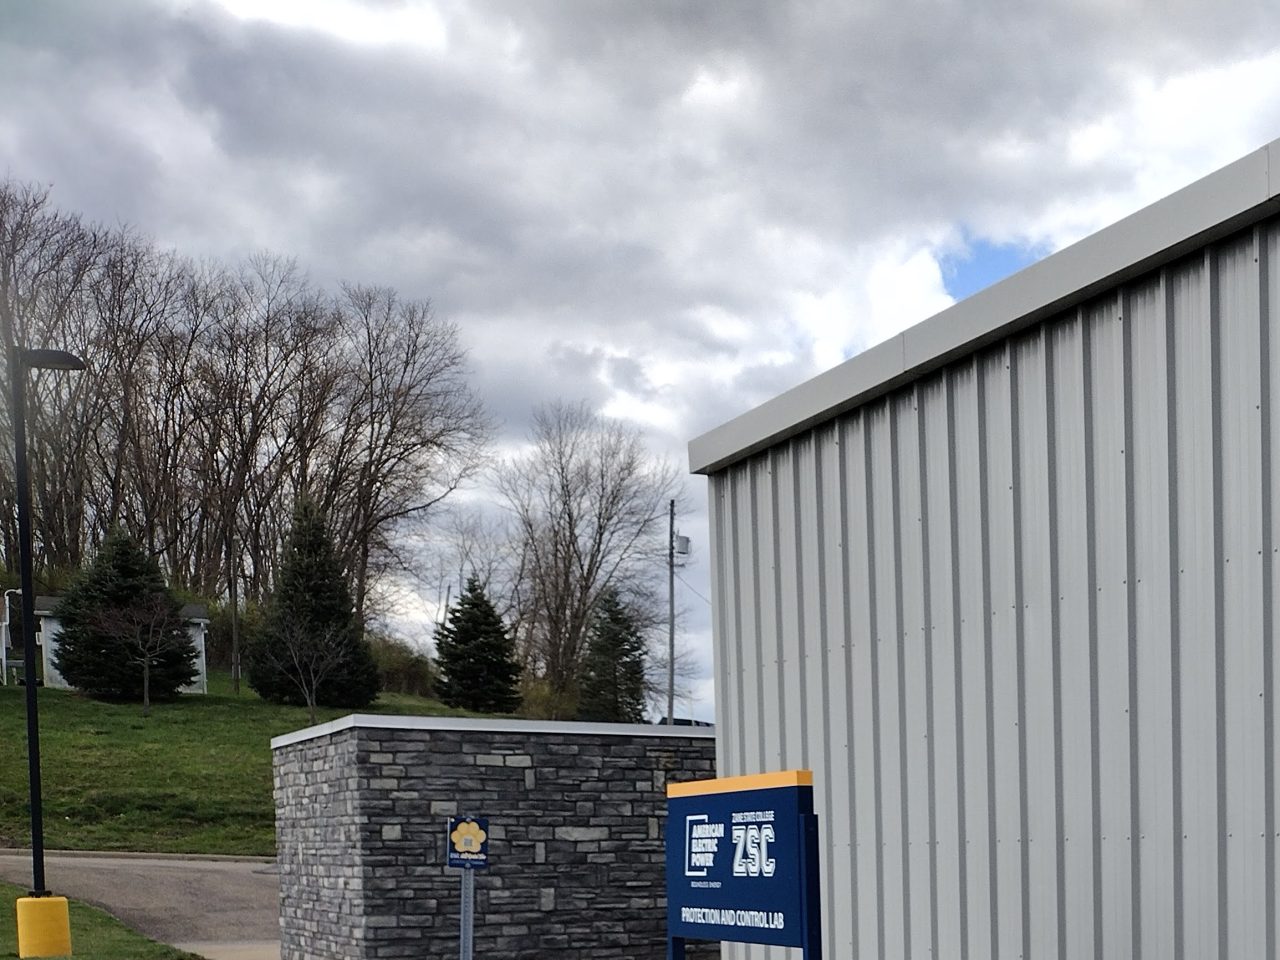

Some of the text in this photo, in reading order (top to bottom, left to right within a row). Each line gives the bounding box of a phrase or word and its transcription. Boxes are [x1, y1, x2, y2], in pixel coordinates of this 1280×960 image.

[692, 824, 725, 838] AMERICAN
[691, 838, 718, 853] ELECTRIC
[732, 824, 776, 877] ZSC
[691, 853, 714, 867] POWER
[681, 907, 785, 929] PROTECTION AND CONTROL LAB
